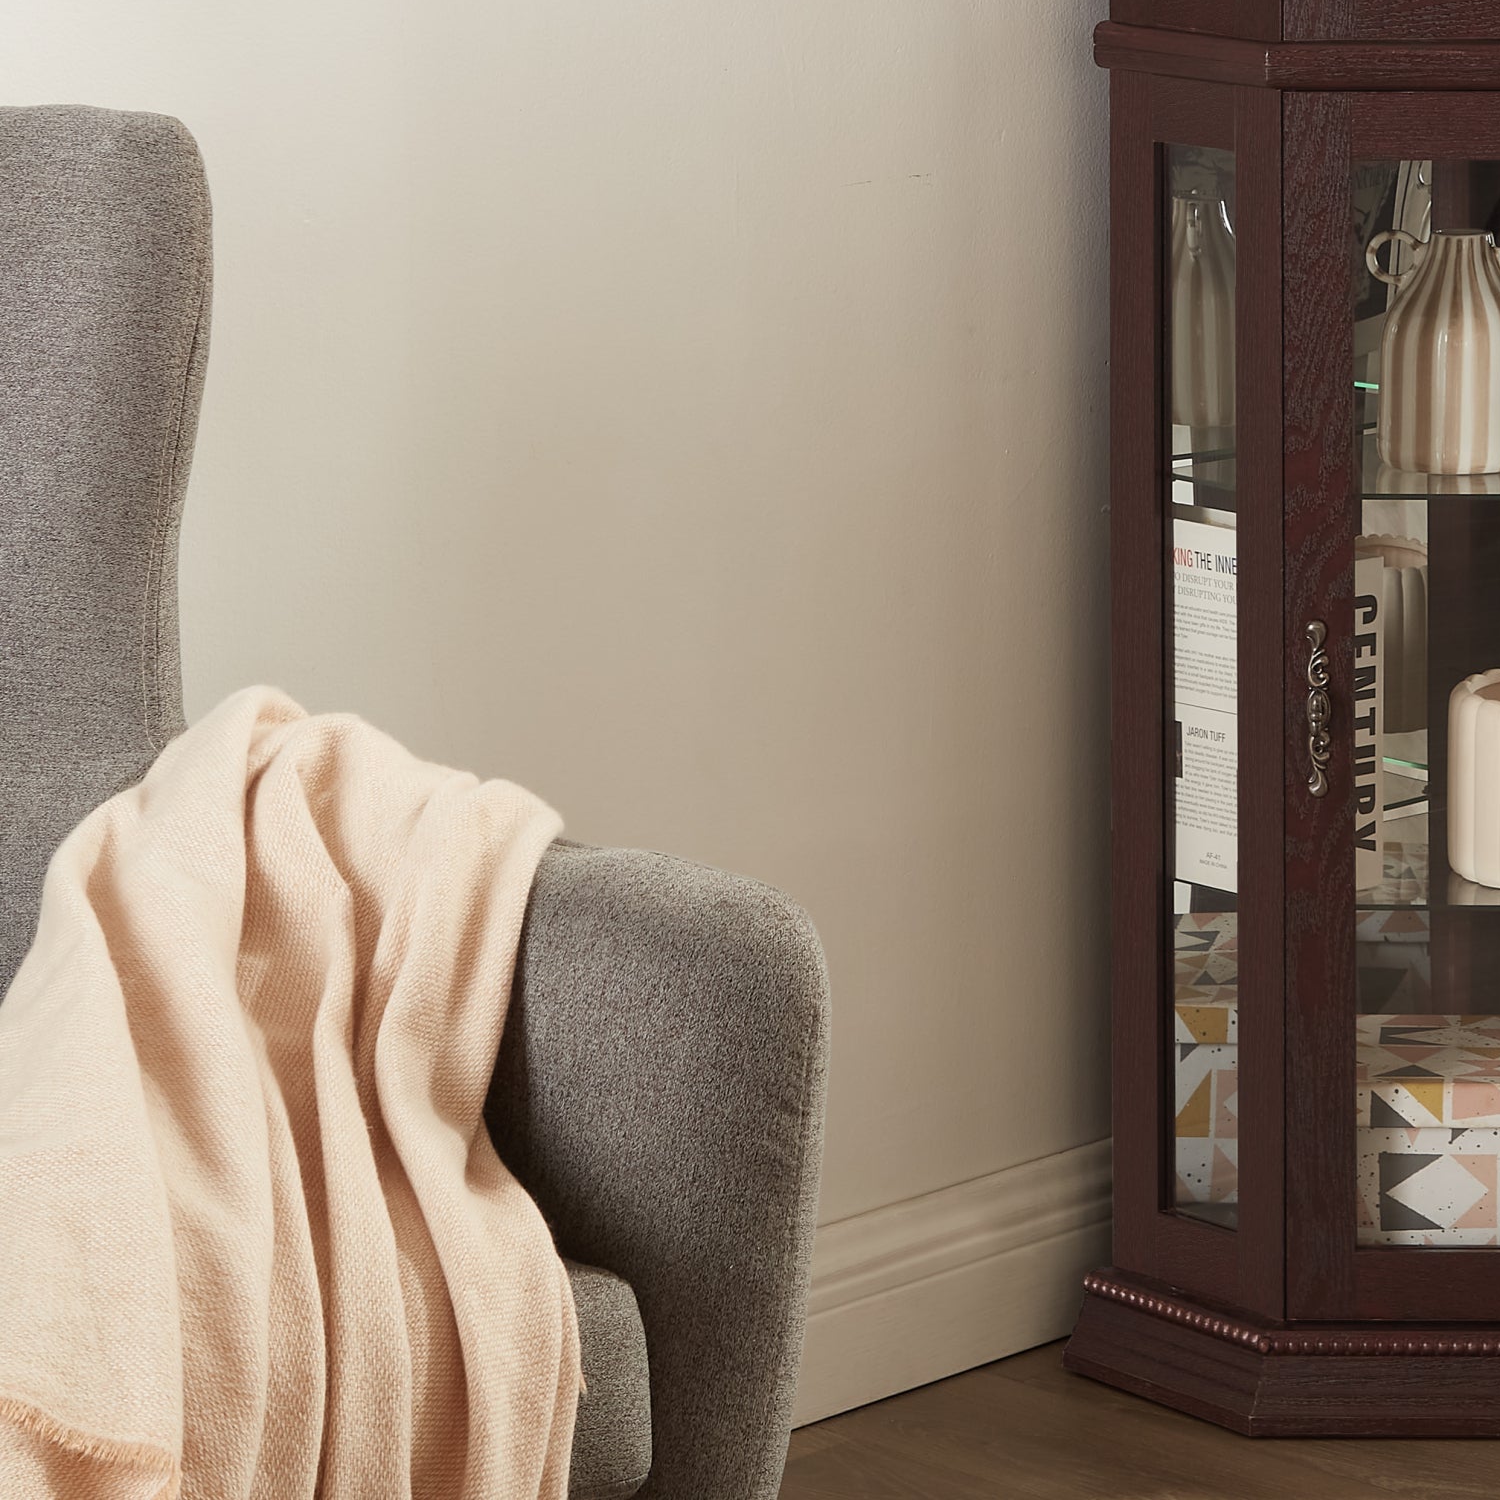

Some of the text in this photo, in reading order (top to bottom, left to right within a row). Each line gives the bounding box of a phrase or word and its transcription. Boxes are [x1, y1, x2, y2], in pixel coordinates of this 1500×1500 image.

[1194, 551, 1212, 570] THE
[1182, 573, 1212, 587] DISRUPT
[1213, 578, 1235, 591] YOUR
[1177, 585, 1221, 603] DISRUPTING
[1354, 594, 1378, 852] CENTURY
[1209, 730, 1226, 743] TUFF
